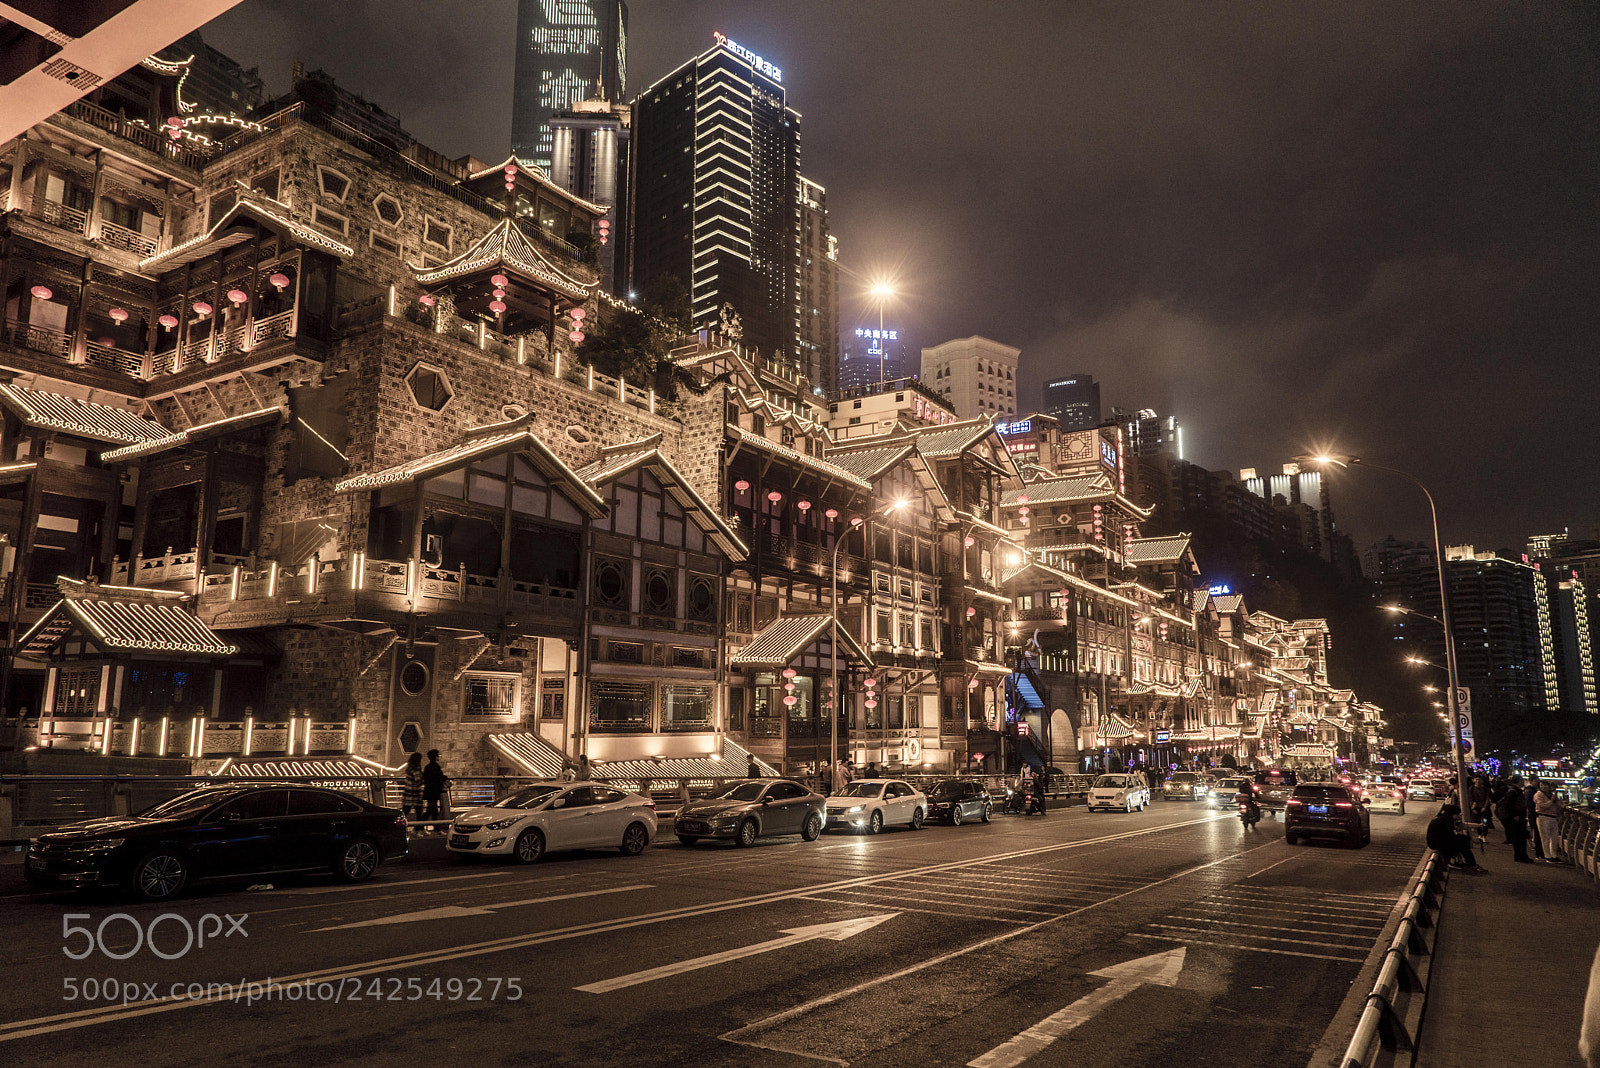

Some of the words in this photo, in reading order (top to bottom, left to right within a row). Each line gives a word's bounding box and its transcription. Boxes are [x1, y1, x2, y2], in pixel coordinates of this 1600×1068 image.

[855, 328, 898, 340] 中央商务区
